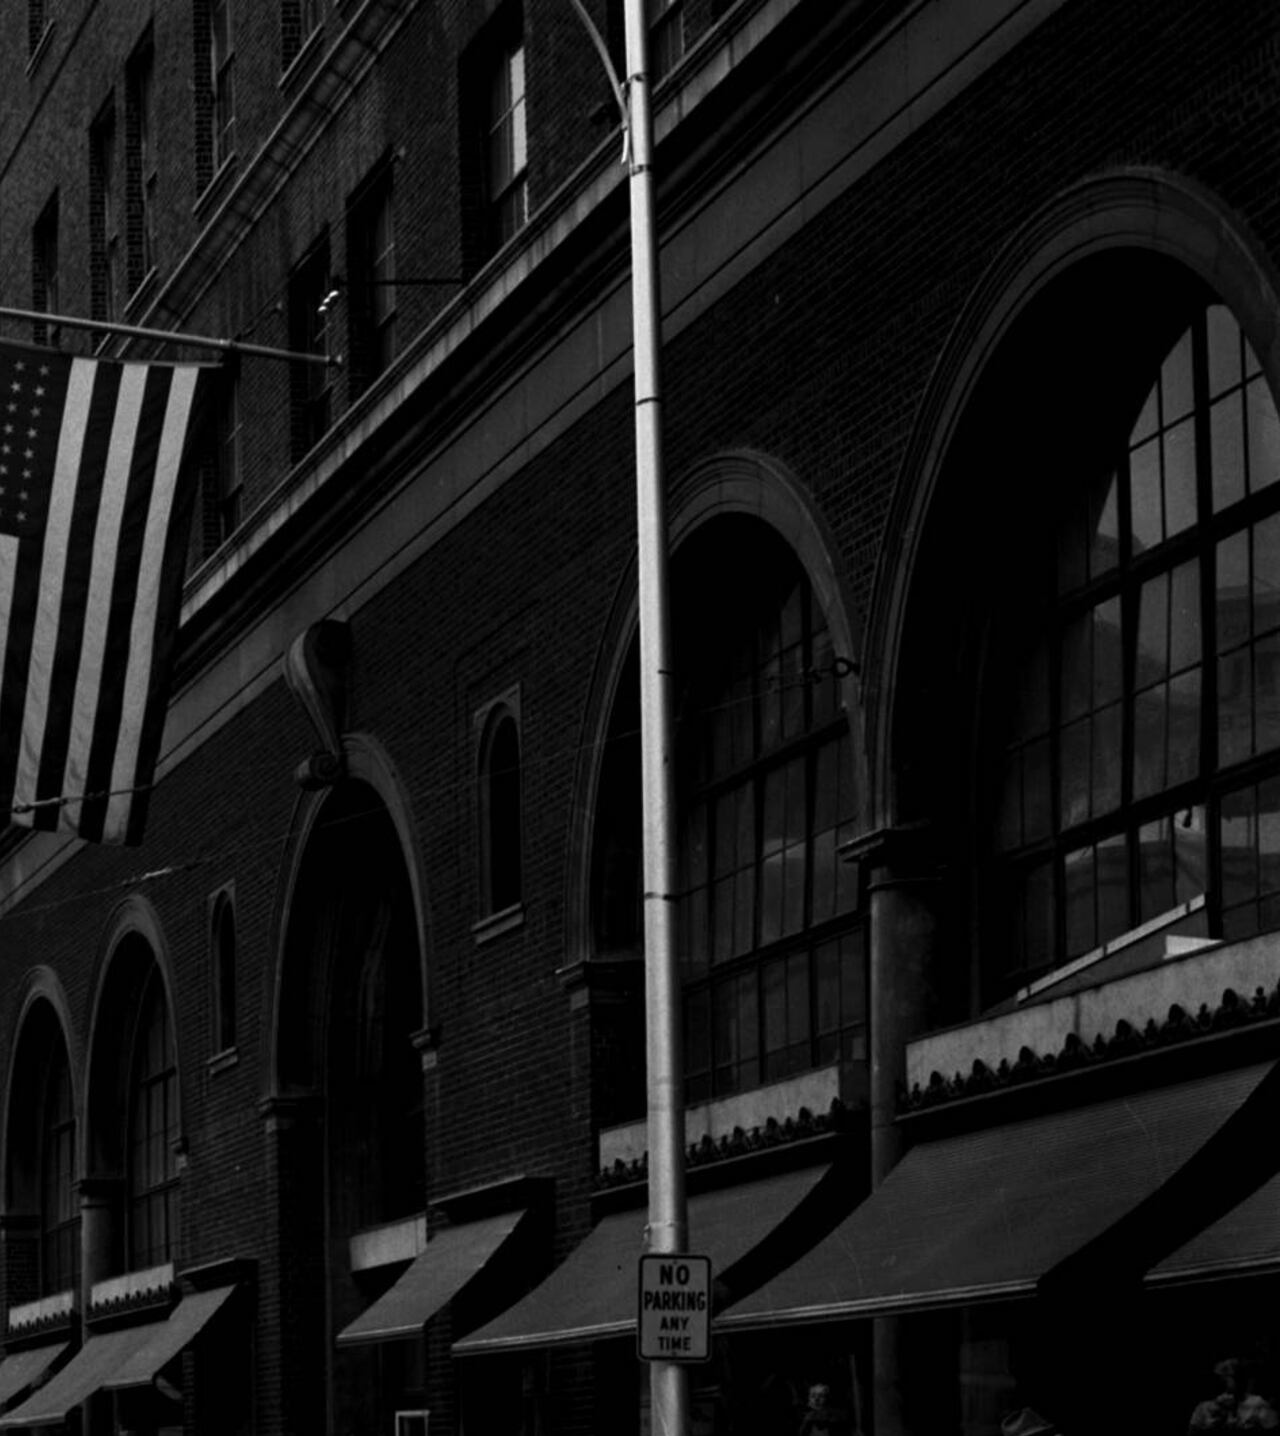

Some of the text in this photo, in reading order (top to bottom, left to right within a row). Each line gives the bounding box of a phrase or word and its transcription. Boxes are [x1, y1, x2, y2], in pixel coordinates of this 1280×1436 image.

[660, 1264, 690, 1286] NO
[644, 1290, 706, 1311] PARKING
[660, 1316, 689, 1331] ANY
[657, 1336, 692, 1351] TIME
